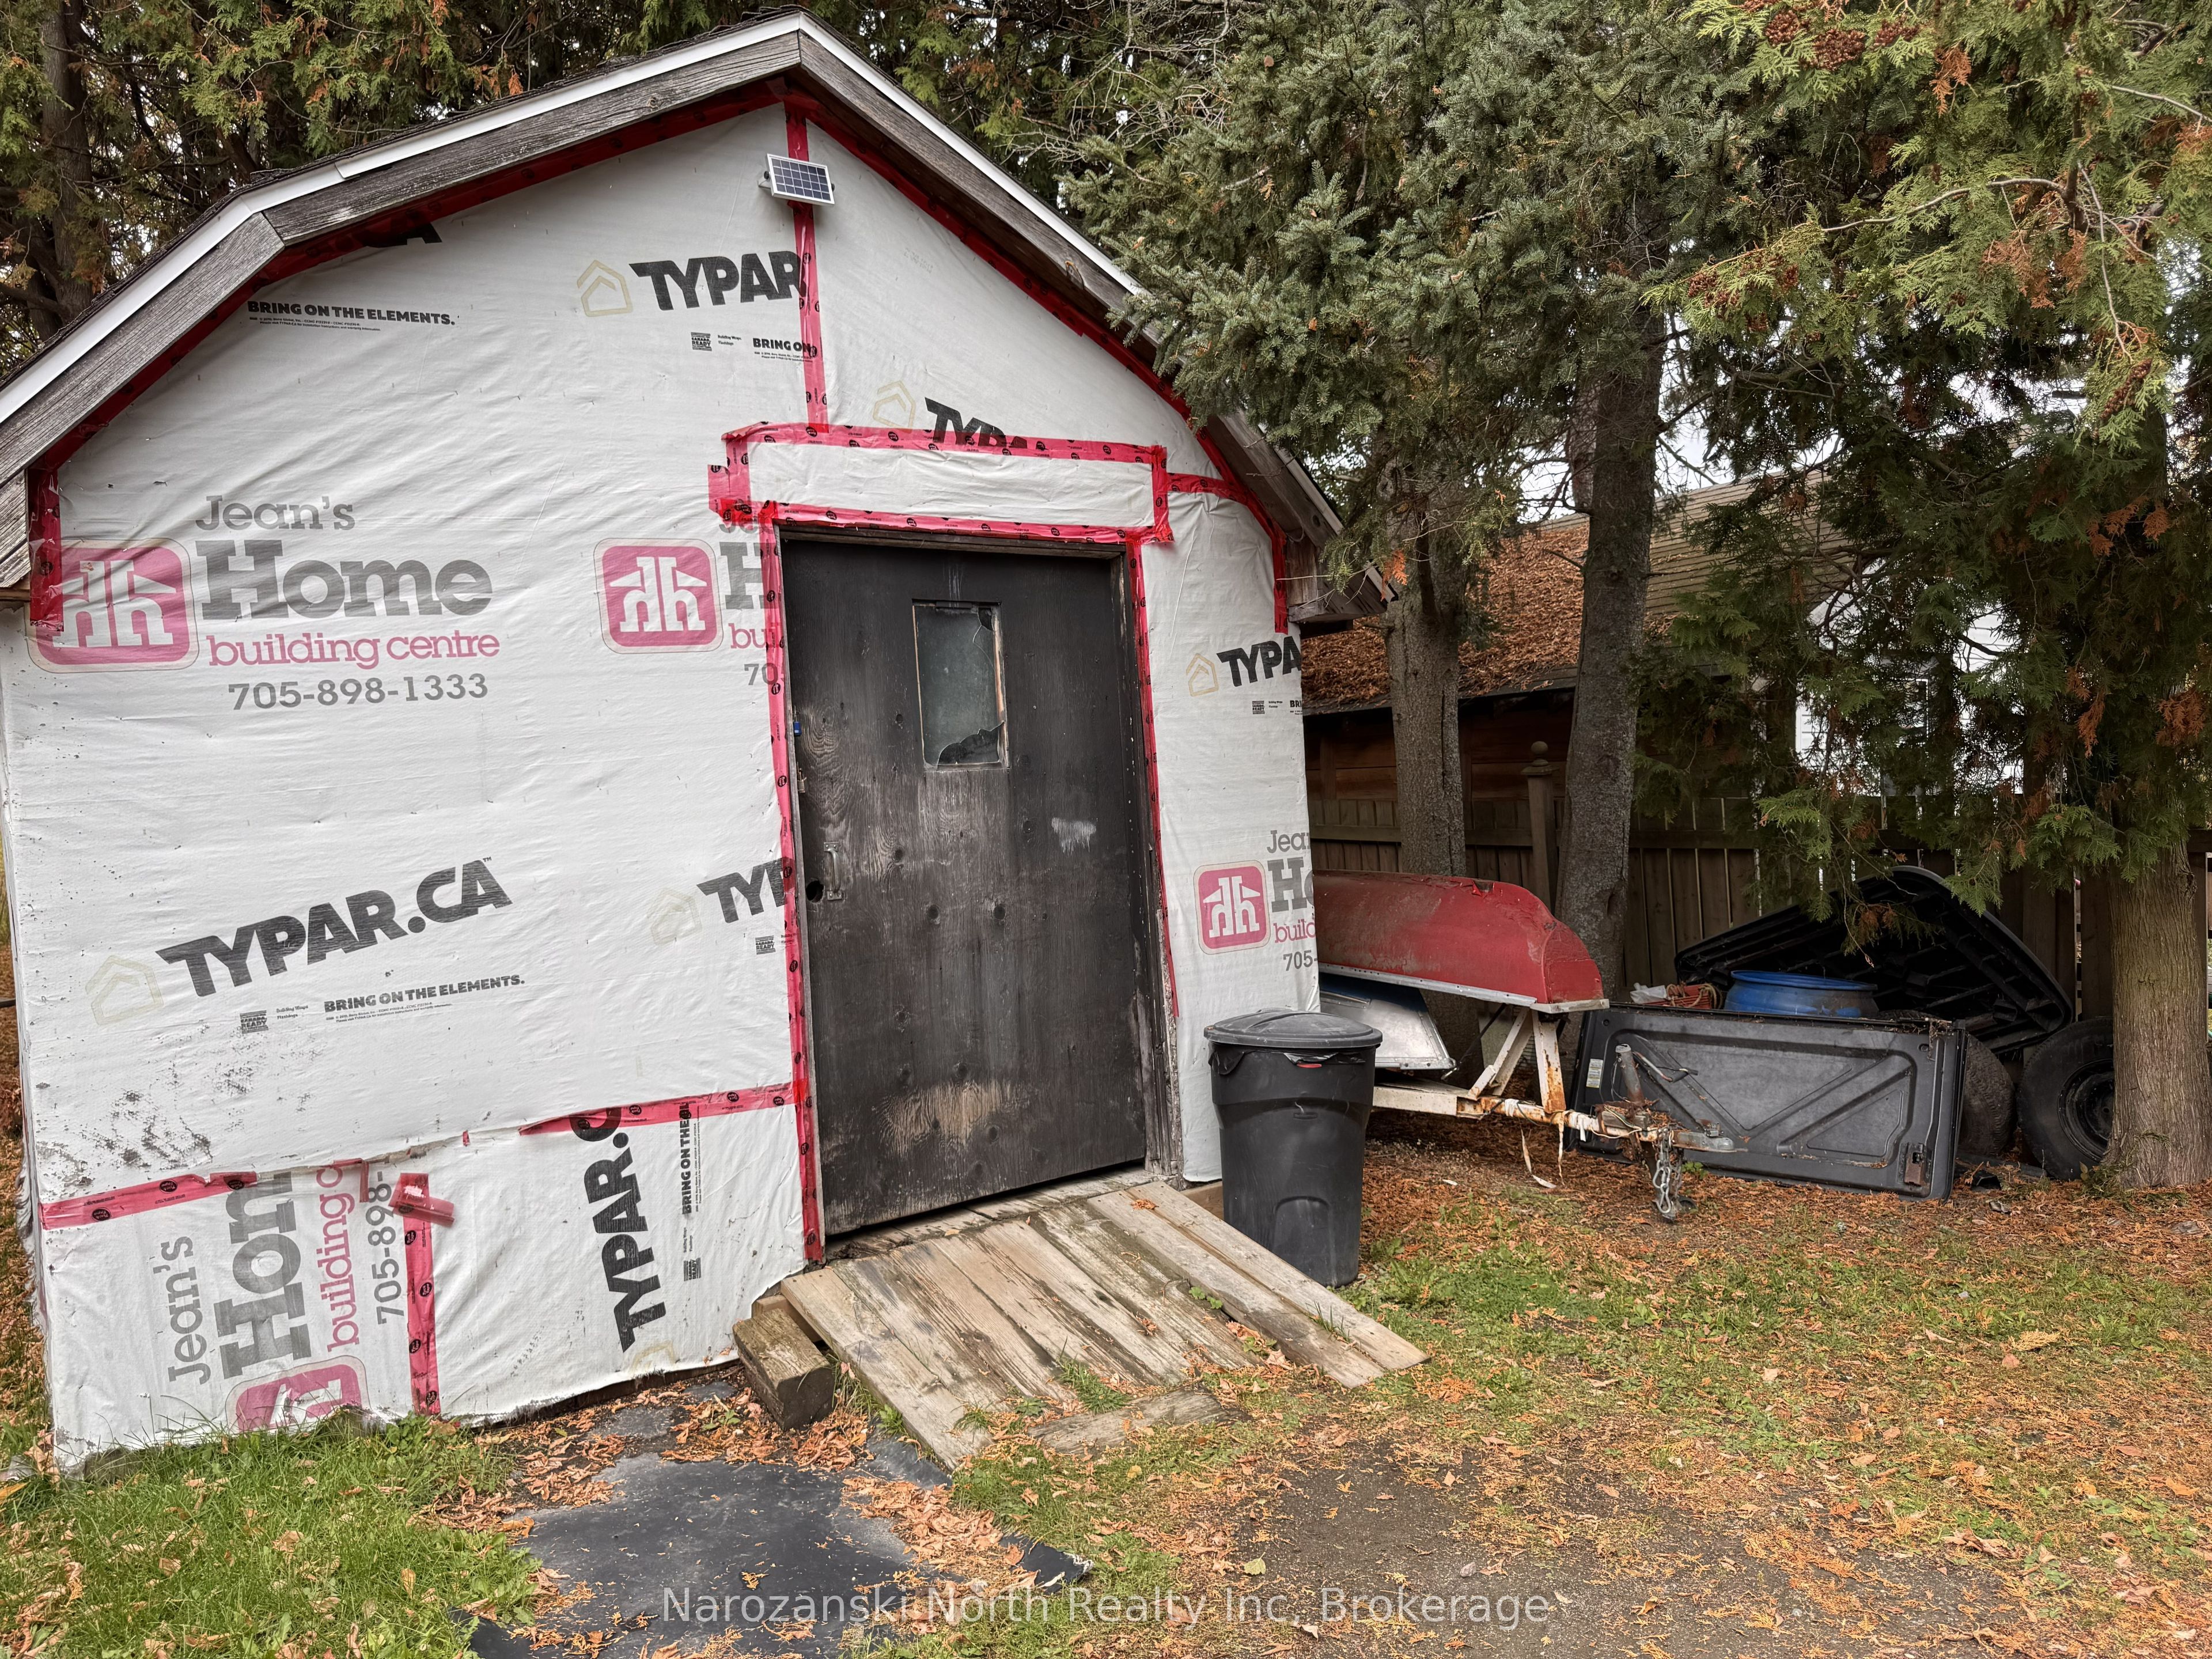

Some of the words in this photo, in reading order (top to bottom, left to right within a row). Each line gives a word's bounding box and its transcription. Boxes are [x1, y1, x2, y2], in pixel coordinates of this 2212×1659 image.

[629, 251, 806, 310] TYPAR
[248, 301, 301, 315] BRING
[305, 304, 329, 317] ON
[332, 306, 364, 320] THE
[367, 308, 456, 325] ELEMENTS.
[753, 338, 791, 351] BRING
[196, 495, 355, 531] Jean's
[195, 540, 493, 619] Home
[206, 633, 380, 669] building
[387, 630, 500, 660] centre
[229, 673, 488, 711] 705-898-1333
[155, 859, 512, 997] TYPAR.CA
[324, 994, 376, 1013] BRING
[379, 991, 404, 1005] ON
[405, 986, 437, 1001] THE
[439, 975, 525, 996] ELEMENTS.
[680, 1120, 690, 1147] THE
[680, 1148, 691, 1169] ON
[681, 1171, 692, 1214] BRING
[317, 1192, 359, 1352] building
[153, 1236, 211, 1385] Jean's
